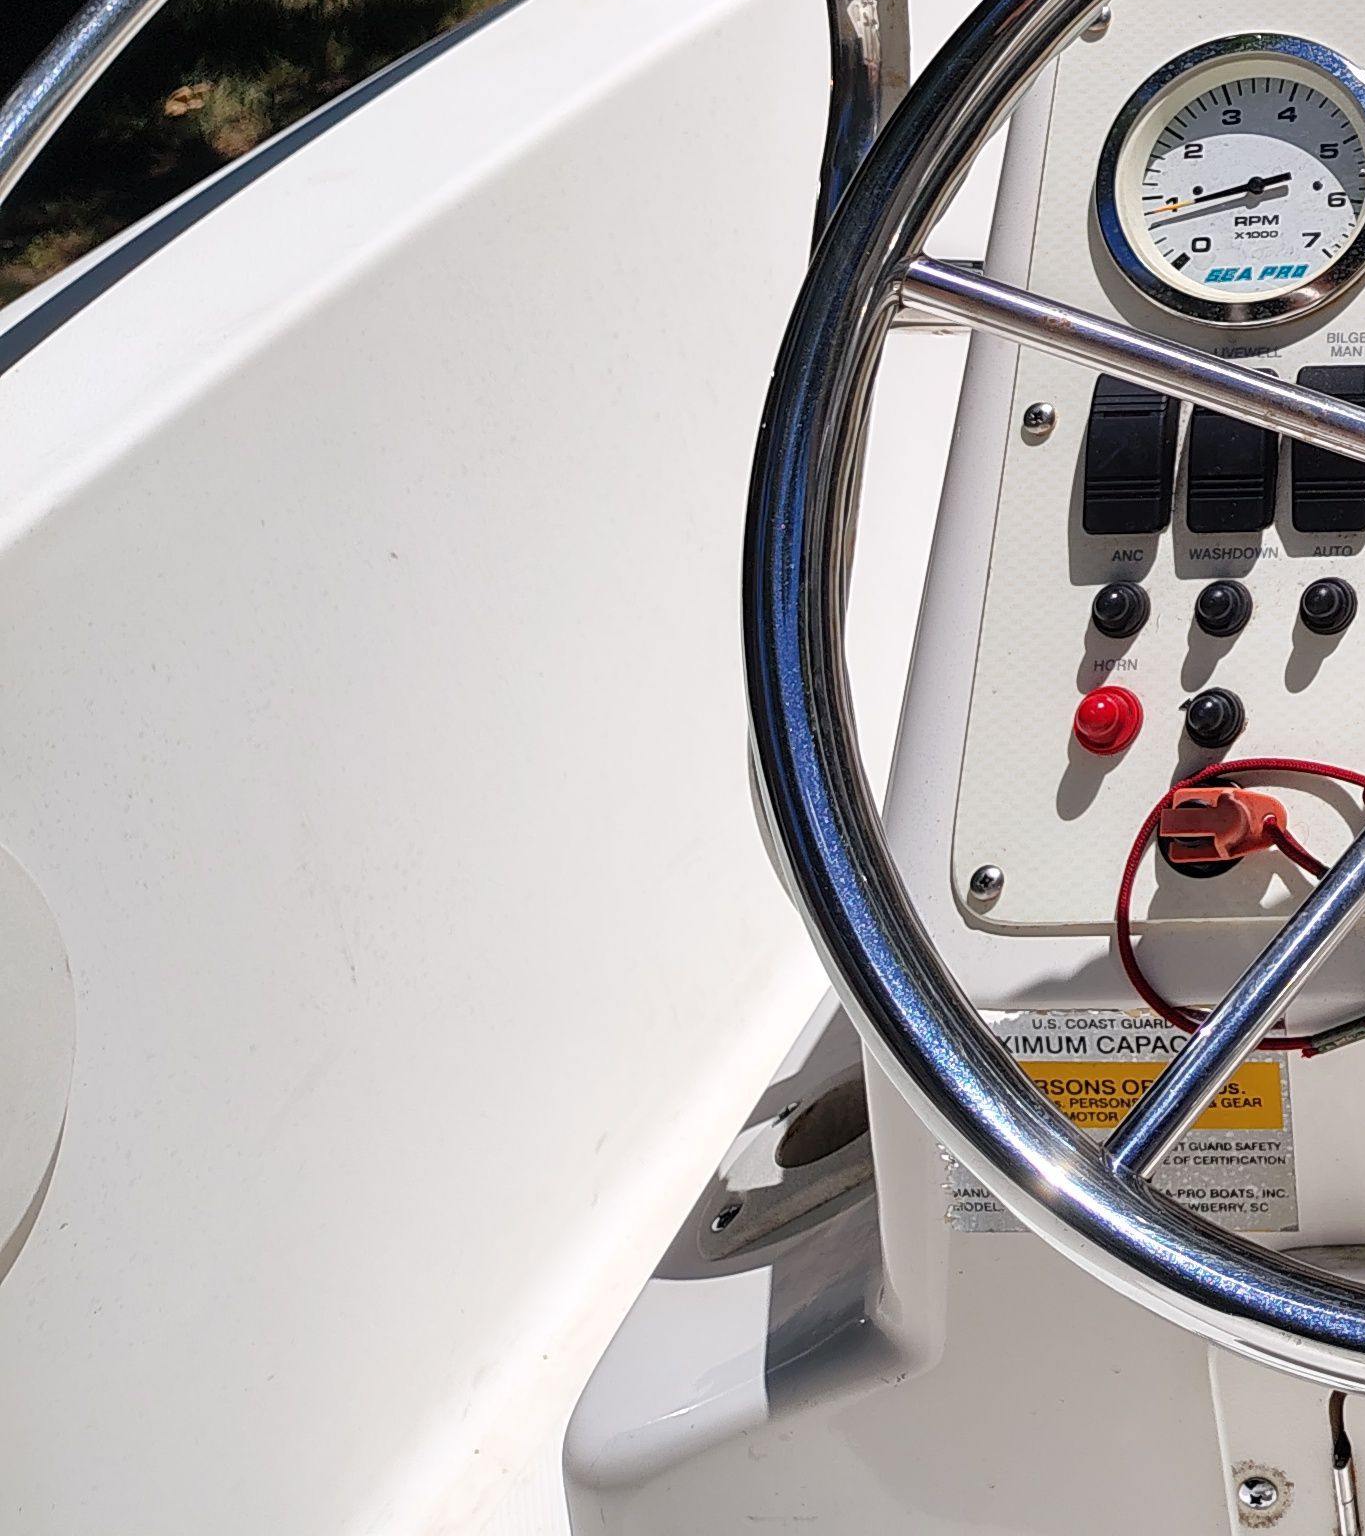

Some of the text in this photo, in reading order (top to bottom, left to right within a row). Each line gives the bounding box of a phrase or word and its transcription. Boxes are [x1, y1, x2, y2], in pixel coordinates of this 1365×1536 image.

[1221, 109, 1242, 125] 3
[1277, 106, 1297, 124] 4
[1184, 143, 1204, 159] 2
[1319, 143, 1339, 159] 5
[1164, 197, 1180, 213] 1
[1327, 191, 1346, 207] 6
[1234, 214, 1280, 227] RPM
[1191, 235, 1212, 253] 0
[1302, 232, 1322, 248] 7
[1204, 263, 1310, 283] SEA PRO
[1213, 346, 1283, 358] LIVEWELL
[1330, 345, 1363, 357] MAN
[1112, 549, 1144, 562] ANC
[1189, 547, 1279, 561] WASHDOWN
[1313, 545, 1353, 558] AUTO
[1094, 658, 1139, 672] HORN
[1032, 1018, 1175, 1030] U.S. COAST GUARD
[1002, 1035, 1188, 1054] XIMUM CAPAC
[1035, 1079, 1116, 1096] RSONS
[1221, 1098, 1263, 1108] GEAR
[1190, 1142, 1232, 1151] GUARD
[1234, 1142, 1282, 1151] SAFETY
[1174, 1155, 1190, 1165] OF
[1194, 1155, 1287, 1165] CERTIFICATION
[1164, 1188, 1290, 1200] A-PRO BOATS, INC.
[1250, 1202, 1269, 1213] SC
